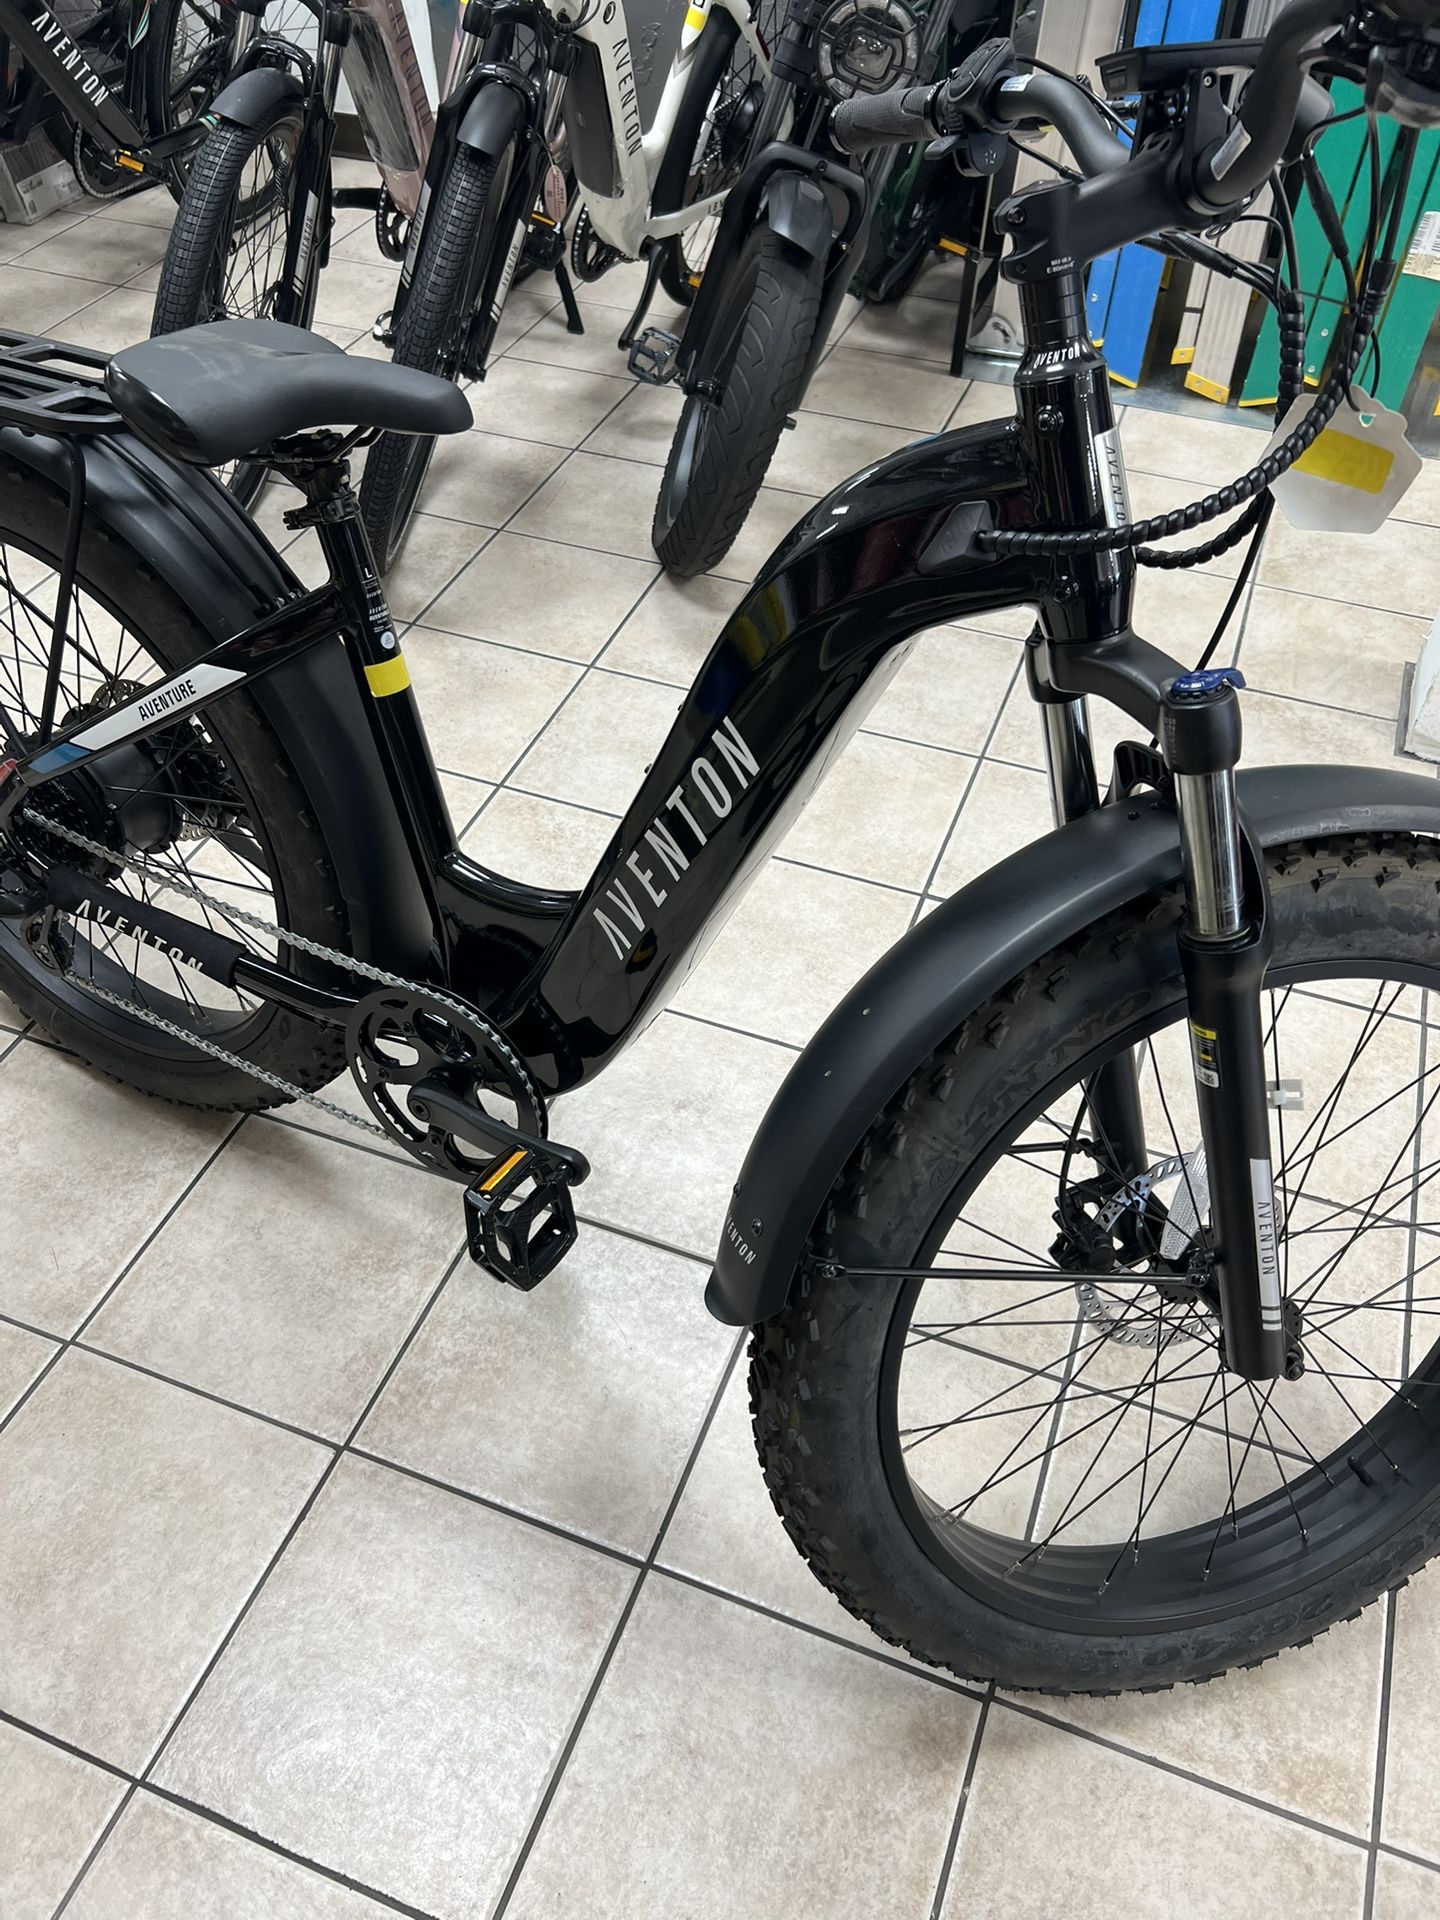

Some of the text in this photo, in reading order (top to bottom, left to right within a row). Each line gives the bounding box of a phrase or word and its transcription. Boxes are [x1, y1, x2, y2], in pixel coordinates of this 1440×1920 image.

[31, 11, 110, 107] AVENTON
[611, 37, 643, 158] AVENTON
[501, 243, 520, 289] AVENTON
[1033, 341, 1080, 370] AVENTON
[1105, 445, 1127, 522] AVENTO
[138, 679, 197, 721] AVENTURE
[593, 715, 761, 961] AVENTON
[75, 898, 204, 972] AVENTON
[1257, 1201, 1276, 1276] AVENTON
